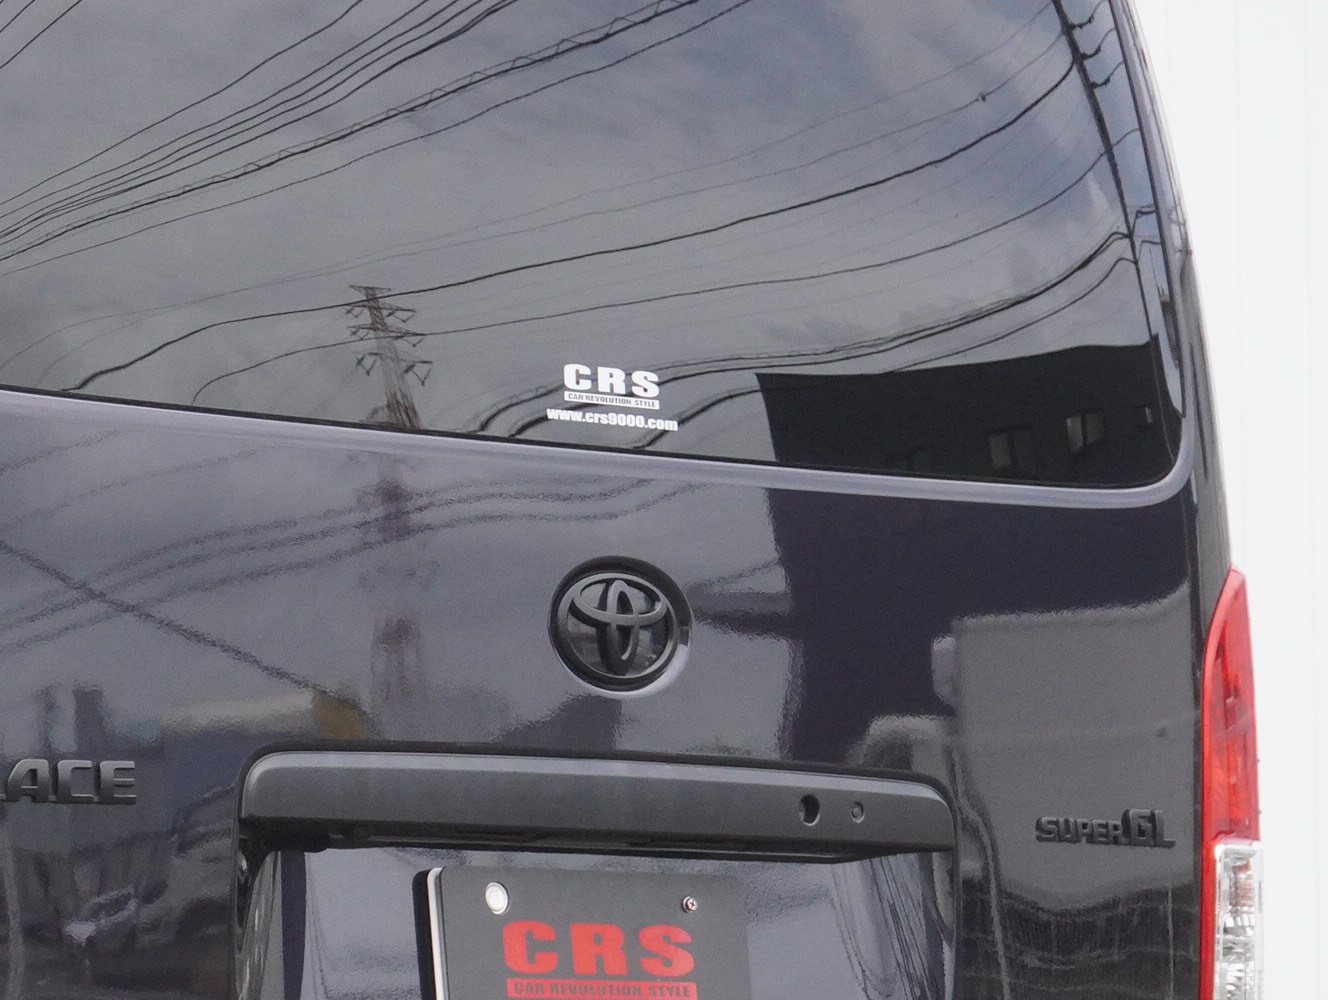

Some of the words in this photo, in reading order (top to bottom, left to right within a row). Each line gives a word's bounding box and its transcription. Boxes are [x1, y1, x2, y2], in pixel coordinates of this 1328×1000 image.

[563, 363, 660, 398] CRS
[568, 392, 584, 401] CAR
[585, 394, 632, 406] REVOLUTION
[634, 399, 656, 408] STYLE
[546, 408, 678, 431] www.crs9000.com
[1035, 816, 1122, 845] SUPER
[1122, 808, 1176, 849] GL
[502, 920, 695, 977] CRS
[513, 982, 545, 995] CAR
[549, 983, 643, 997] REVOLUTION
[647, 985, 691, 998] STYLE
